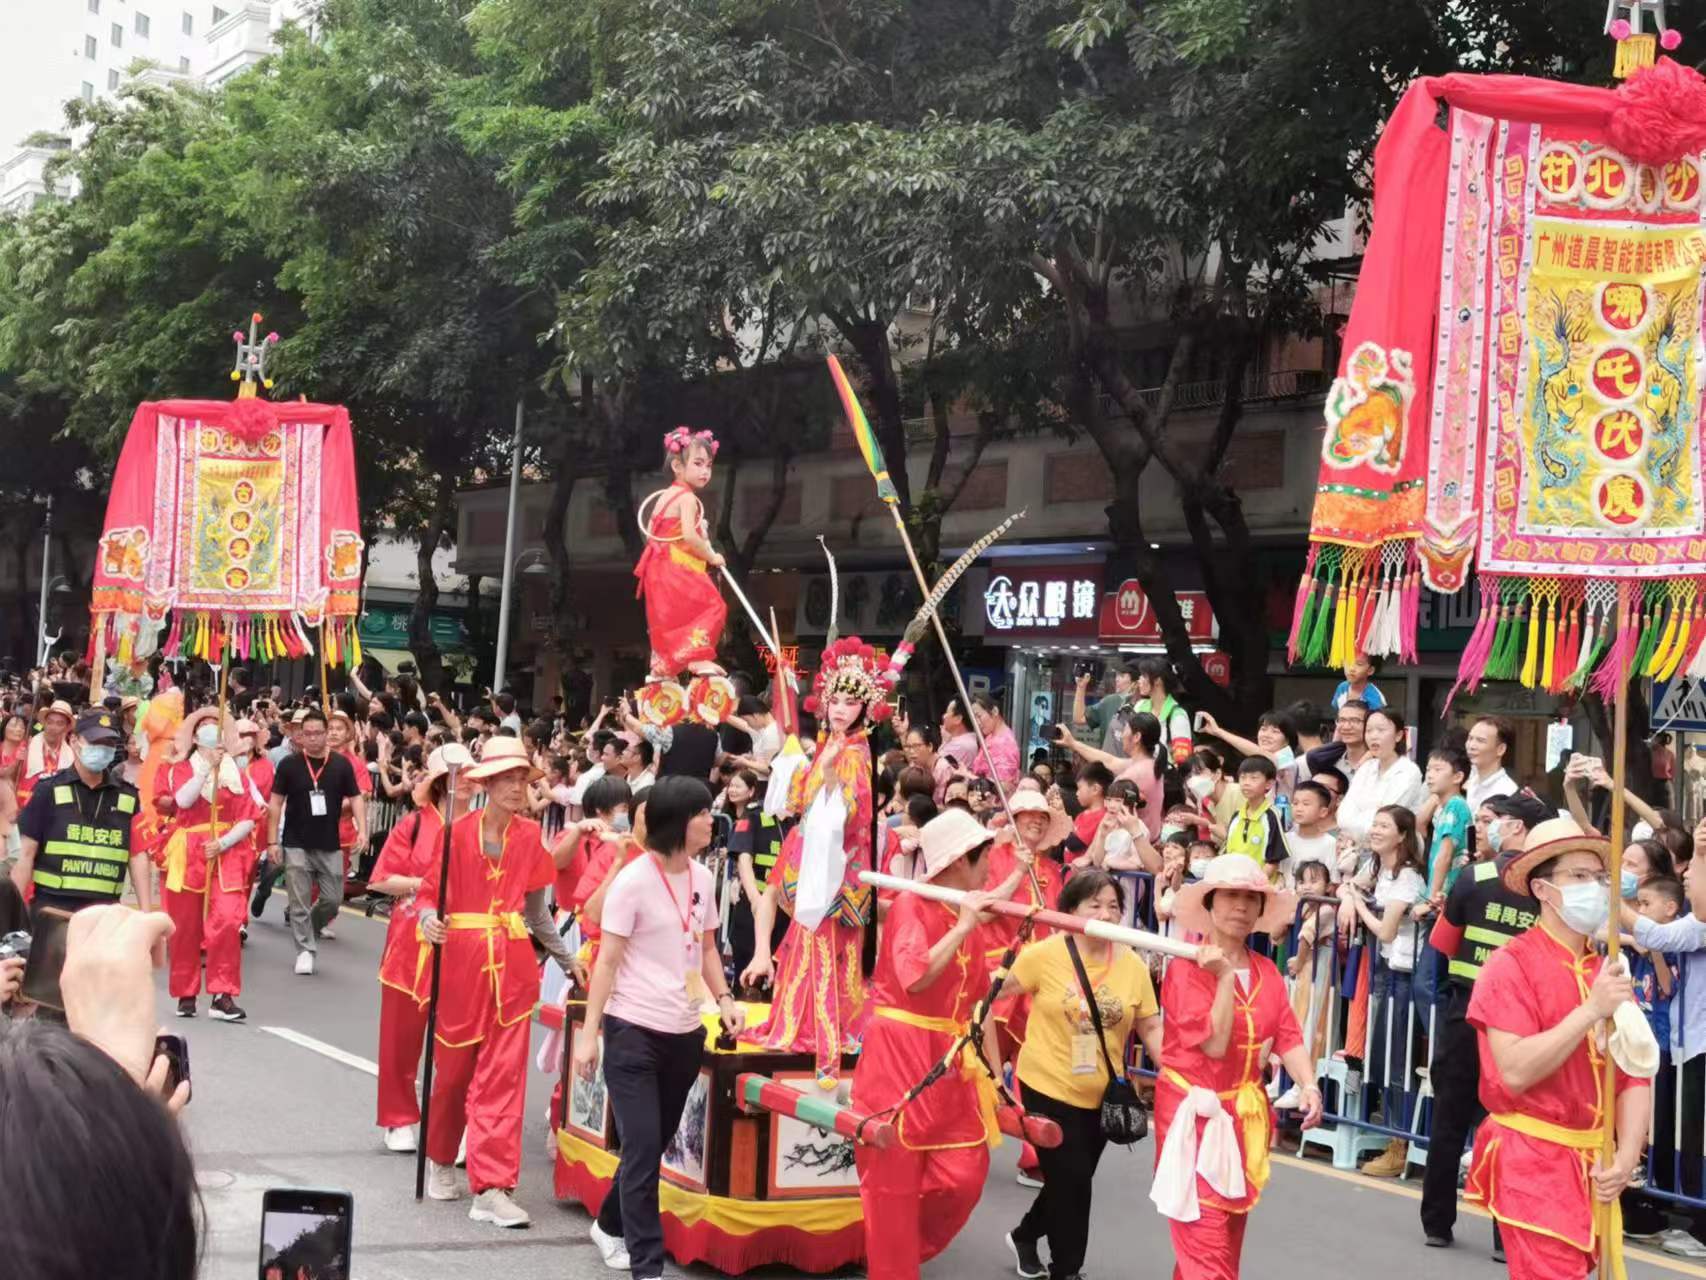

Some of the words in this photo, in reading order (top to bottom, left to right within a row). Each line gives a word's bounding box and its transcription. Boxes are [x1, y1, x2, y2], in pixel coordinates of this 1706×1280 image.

[67, 823, 122, 846] 番禺安保
[62, 858, 93, 875] PANYU
[1485, 902, 1540, 929] 番禺安
